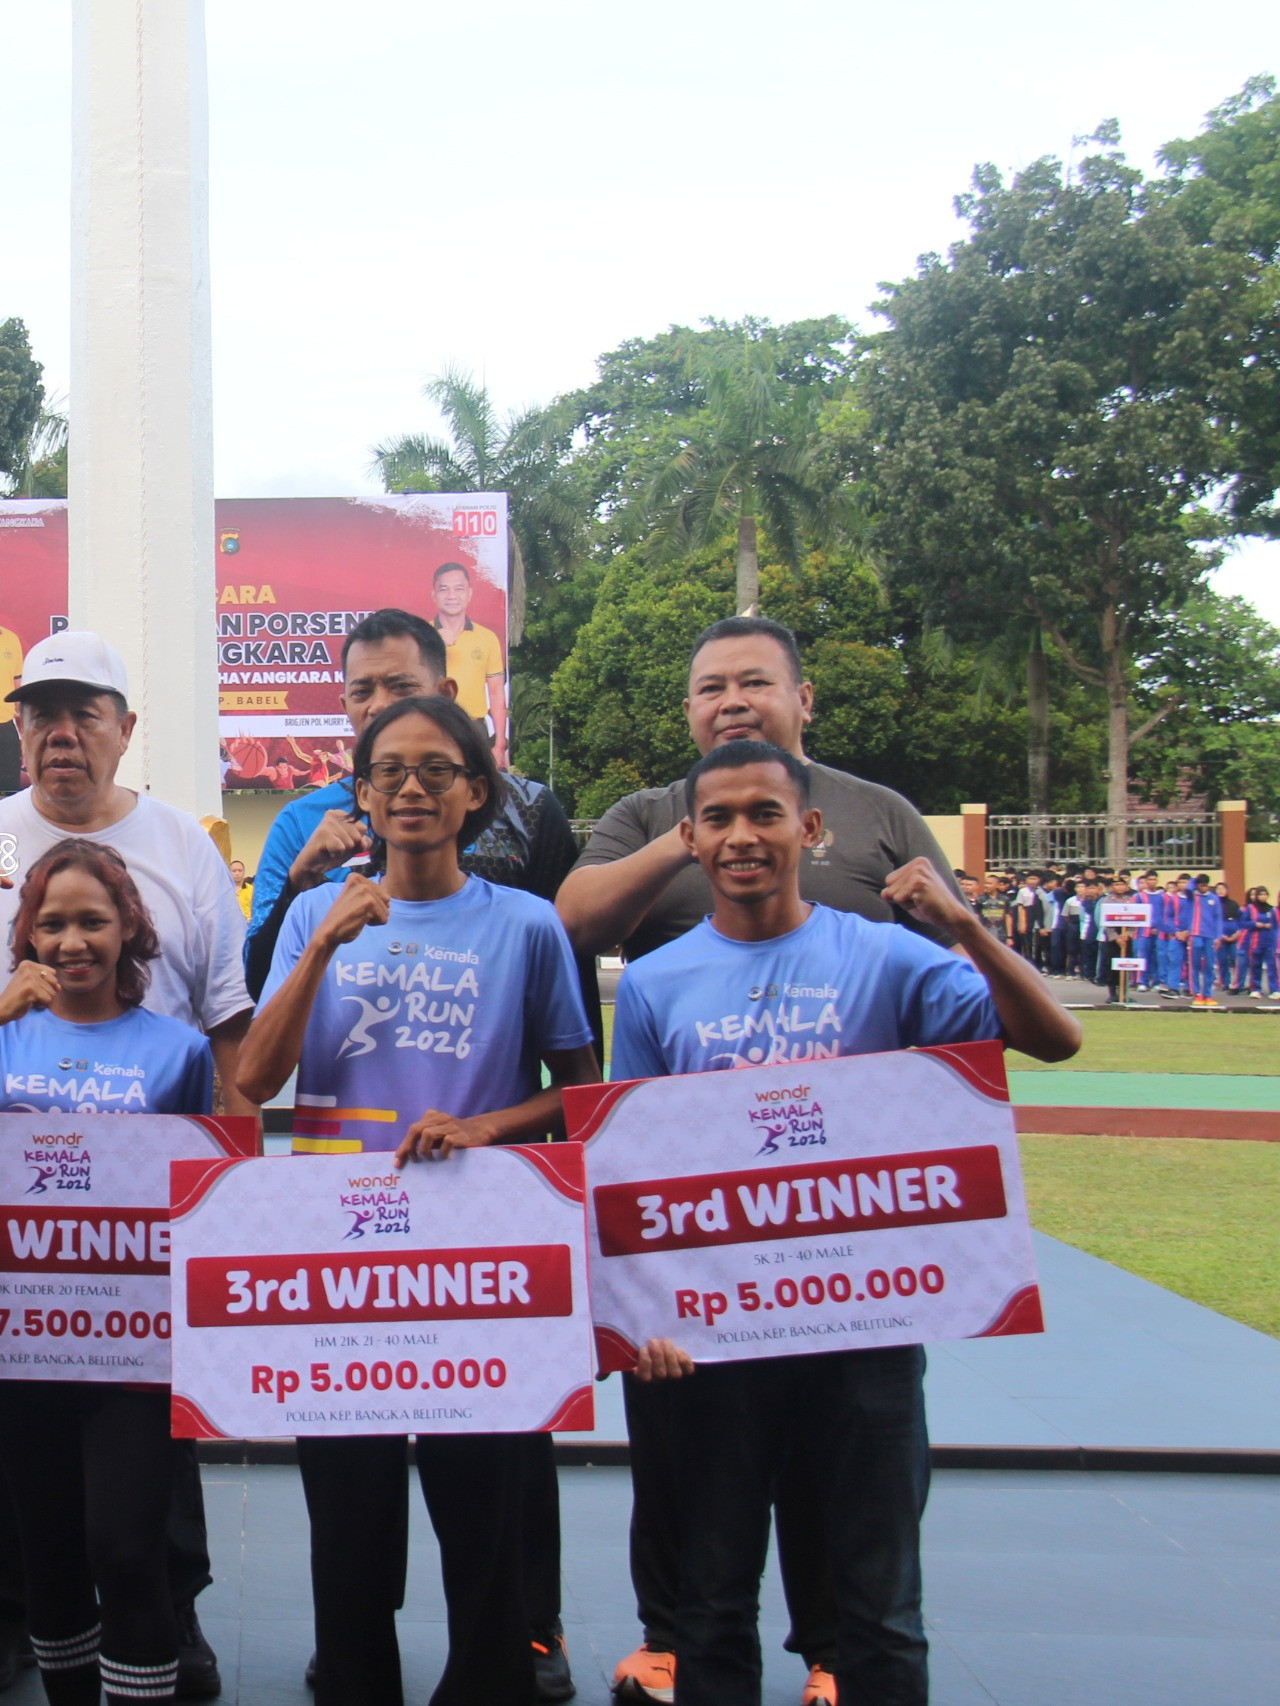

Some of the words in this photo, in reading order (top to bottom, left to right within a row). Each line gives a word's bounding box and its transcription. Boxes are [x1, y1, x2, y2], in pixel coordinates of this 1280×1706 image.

[454, 514, 496, 533] 110
[237, 696, 279, 705] BABEL
[284, 718, 310, 727] BRIGJEN
[324, 717, 344, 726] MURRY
[423, 943, 480, 966] Kemala
[335, 960, 479, 998] KEMALA
[783, 983, 839, 999] Kemala
[405, 991, 475, 1027] RUN
[695, 1003, 842, 1047] KEMALA
[395, 1026, 472, 1060] 2026
[772, 1034, 840, 1064] RUN
[93, 1062, 146, 1079] Kemala
[6, 1073, 147, 1107] KEMALA
[754, 1084, 811, 1103] wondr
[748, 1101, 823, 1123] KEMALA
[788, 1117, 824, 1133] RUN
[32, 1133, 83, 1146] wondr
[788, 1130, 827, 1148] 2026
[24, 1150, 91, 1163] KEMALA
[60, 1163, 90, 1177] RUN
[56, 1176, 91, 1191] 2026
[348, 1173, 401, 1188] wondr
[340, 1190, 410, 1207] KEMALA
[636, 1189, 729, 1240] 3rd
[737, 1165, 962, 1226] WINNER
[376, 1206, 409, 1220] RUN
[374, 1218, 411, 1234] 2026
[7, 1219, 170, 1262] WINNE
[753, 1253, 770, 1265] 5K
[773, 1252, 785, 1264] 21
[796, 1249, 813, 1262] 40
[815, 1245, 854, 1260] MALE
[14, 1284, 55, 1296] UNDER
[58, 1285, 72, 1296] 20
[74, 1285, 122, 1297] FEMALE
[225, 1268, 310, 1314] 3rd
[321, 1260, 530, 1310] WINNER
[675, 1288, 727, 1327] Rp
[737, 1264, 945, 1312] 5.000.000
[717, 1330, 760, 1344] POLDA
[789, 1322, 848, 1338] BANGKA
[850, 1315, 913, 1332] BELITUNG
[314, 1336, 339, 1348] HM
[340, 1336, 361, 1347] 21K
[364, 1335, 375, 1346] 21
[384, 1335, 401, 1346] 40
[402, 1333, 439, 1345] MALE
[34, 1354, 86, 1366] BANGKA
[88, 1355, 144, 1367] BELITUNG
[251, 1365, 300, 1403] Rp
[310, 1358, 507, 1392] 5.000.000
[286, 1411, 327, 1423] POLDA
[355, 1408, 410, 1421] BANGKA
[412, 1408, 473, 1420] BELITUNG
